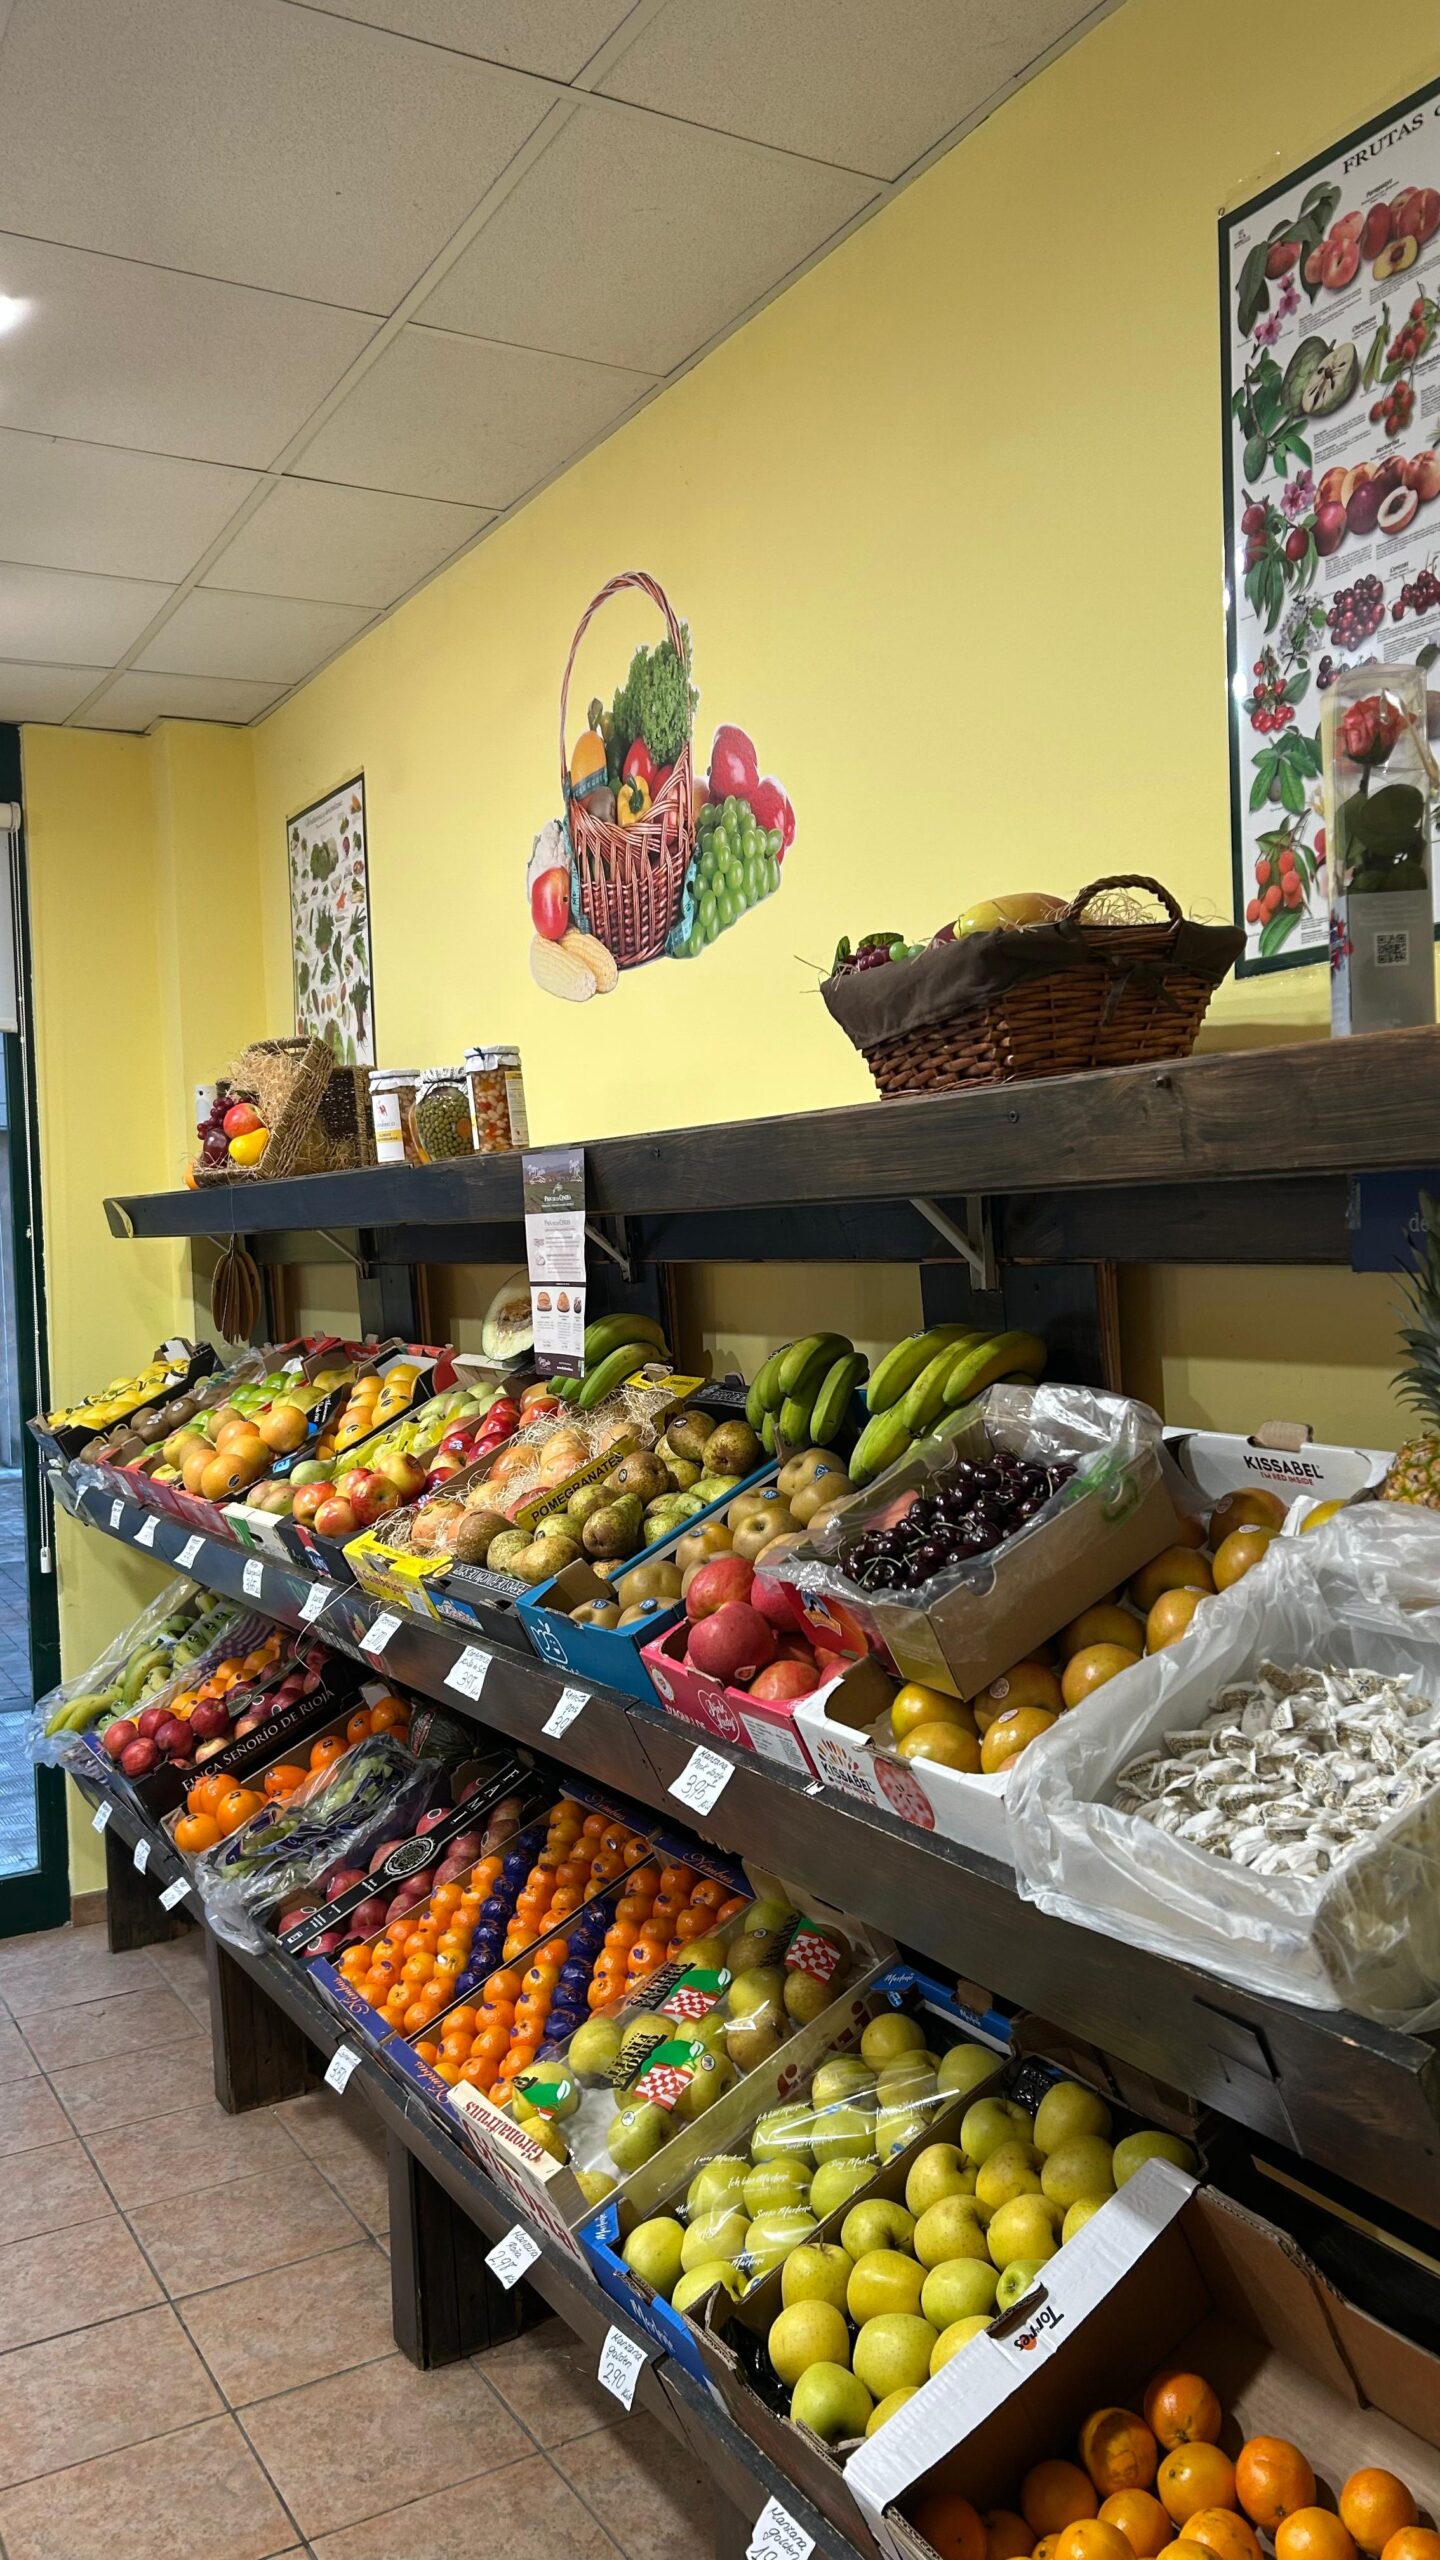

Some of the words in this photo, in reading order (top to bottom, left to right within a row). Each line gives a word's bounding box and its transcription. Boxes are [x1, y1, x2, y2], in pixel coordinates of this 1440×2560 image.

[1343, 113, 1424, 175] FRUTAS
[1243, 1455, 1324, 1479] KISSABEL
[1272, 1473, 1287, 1482] RED
[531, 1452, 624, 1522] POMEGRANATES
[223, 1726, 279, 1765] SEÑORÍO
[280, 1713, 299, 1729] DE
[298, 1690, 335, 1717] RIOJA
[821, 1761, 876, 1795] KISSABEL
[332, 1977, 371, 2015] Nimbus
[1014, 2305, 1065, 2352] Torres
[606, 2345, 633, 2369] golden
[611, 2333, 643, 2362] Manzana
[763, 2527, 800, 2560] golden
[767, 2506, 808, 2552] Manzana
